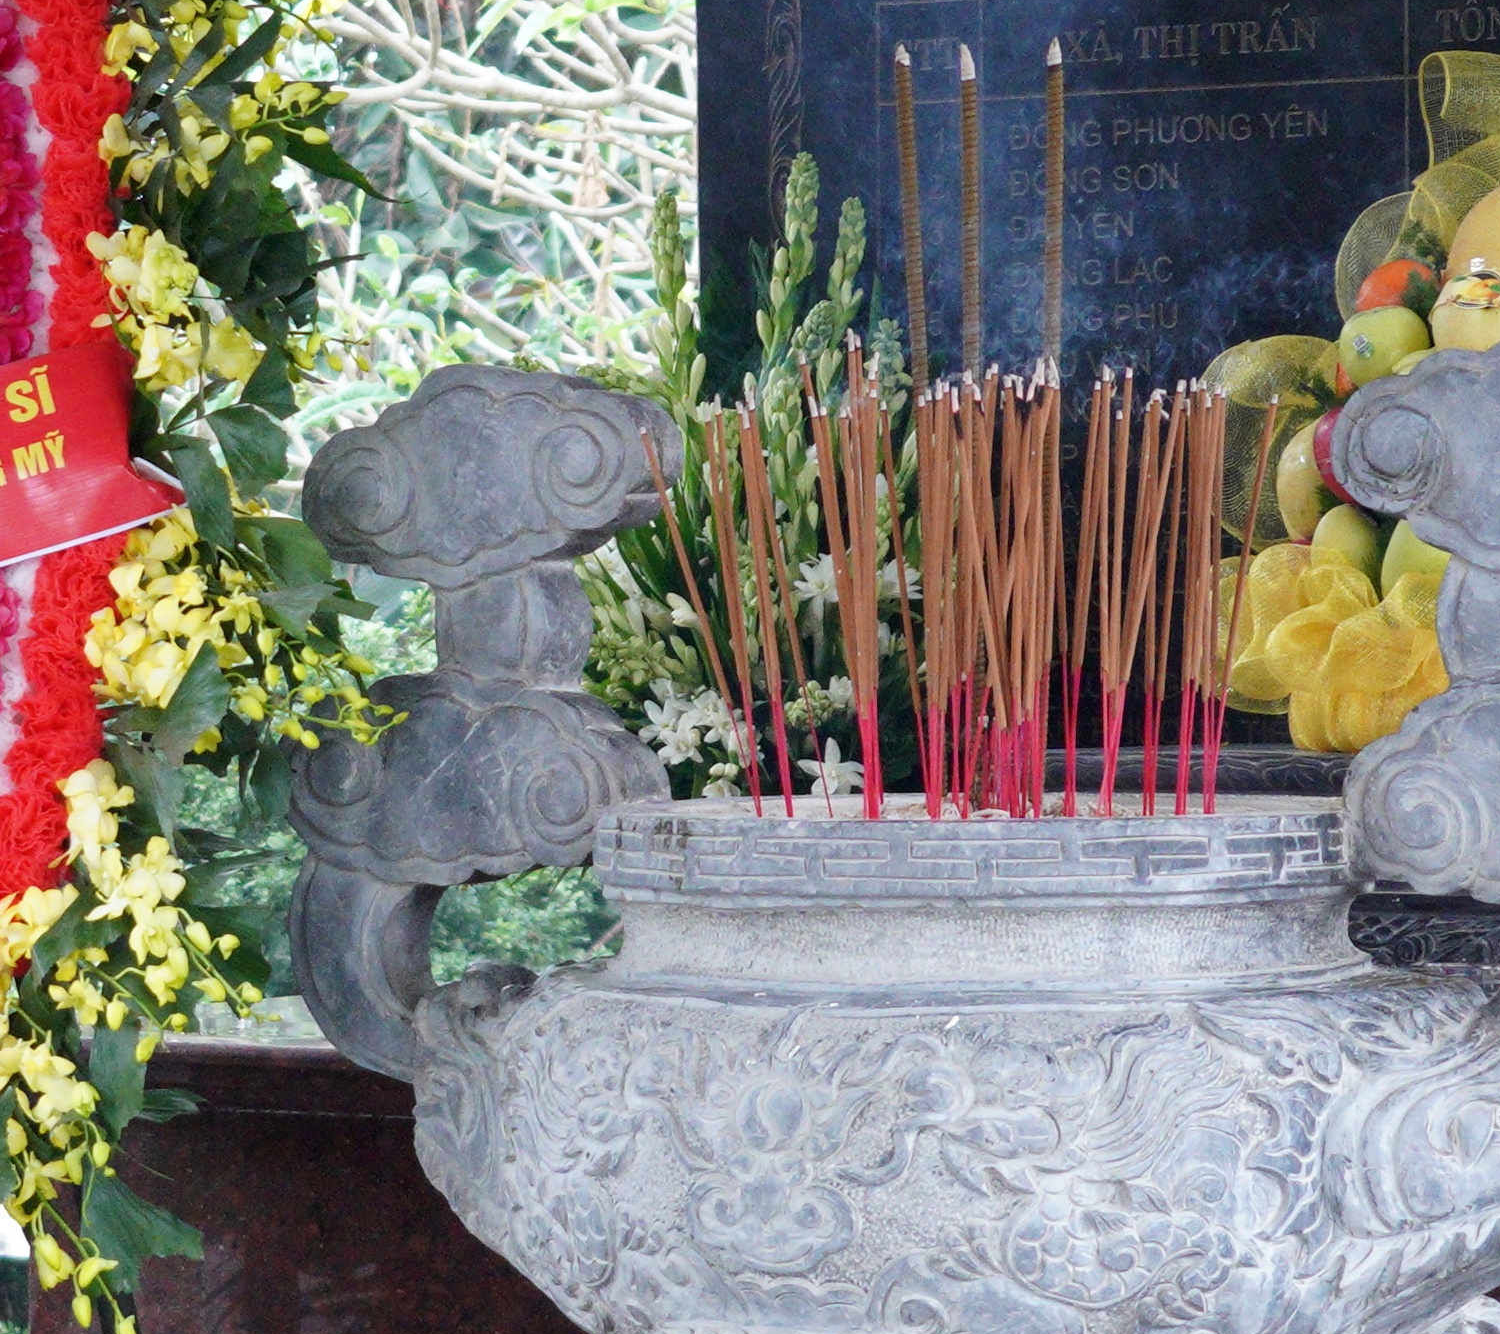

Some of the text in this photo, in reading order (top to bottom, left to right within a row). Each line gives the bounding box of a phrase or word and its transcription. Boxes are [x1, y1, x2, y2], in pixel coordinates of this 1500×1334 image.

[1133, 22, 1201, 67] THỊ
[1211, 4, 1319, 56] TRẤN
[1113, 111, 1252, 146] PHƯƠNG
[1262, 104, 1328, 140] YÊN
[1113, 161, 1179, 192] SƠN
[4, 365, 56, 423] SĨ
[12, 429, 66, 480] MỸ
